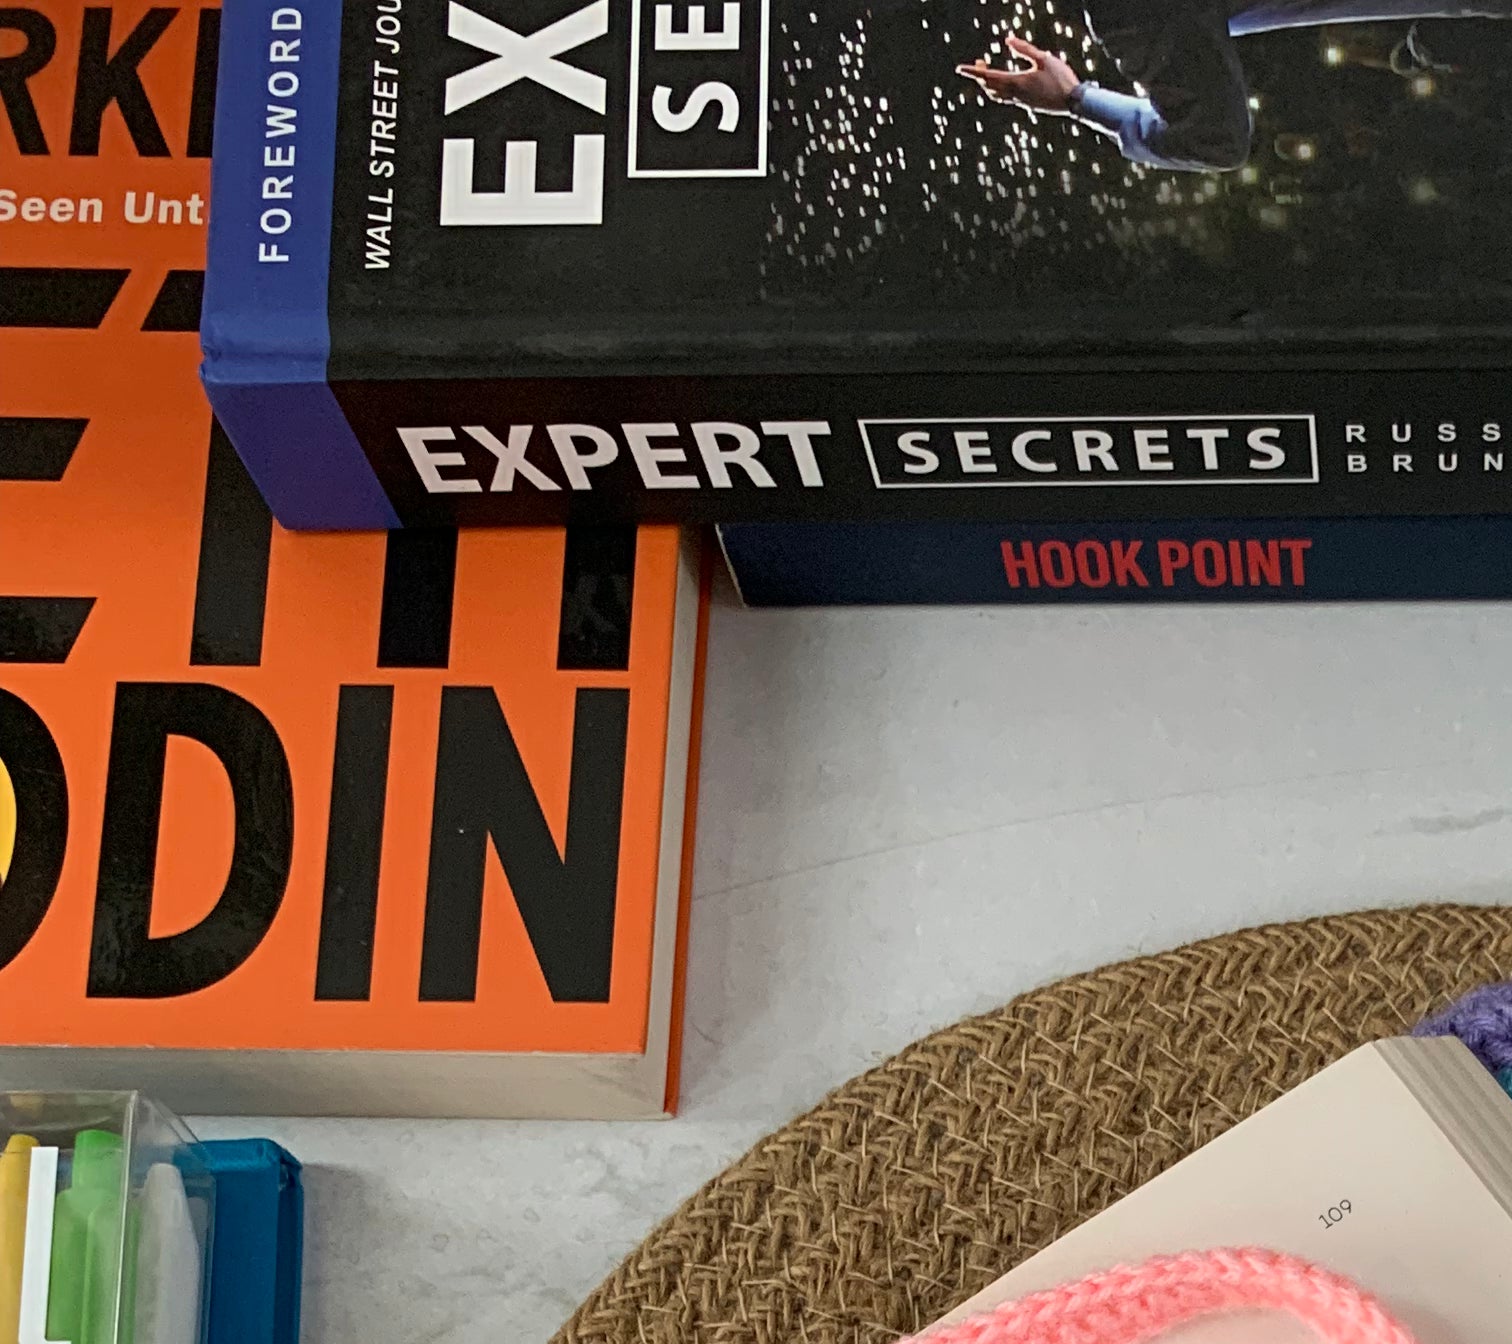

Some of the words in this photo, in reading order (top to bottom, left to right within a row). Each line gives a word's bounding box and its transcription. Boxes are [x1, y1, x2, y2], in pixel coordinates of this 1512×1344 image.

[258, 7, 303, 262] FOREWORD
[368, 60, 399, 178] STREET
[364, 187, 394, 270] WALL
[396, 420, 831, 494] EXPERT
[895, 426, 1287, 475] SECRETS
[1001, 540, 1149, 590] HOOK
[1160, 538, 1313, 587] POINT
[1319, 1198, 1354, 1230] 109
